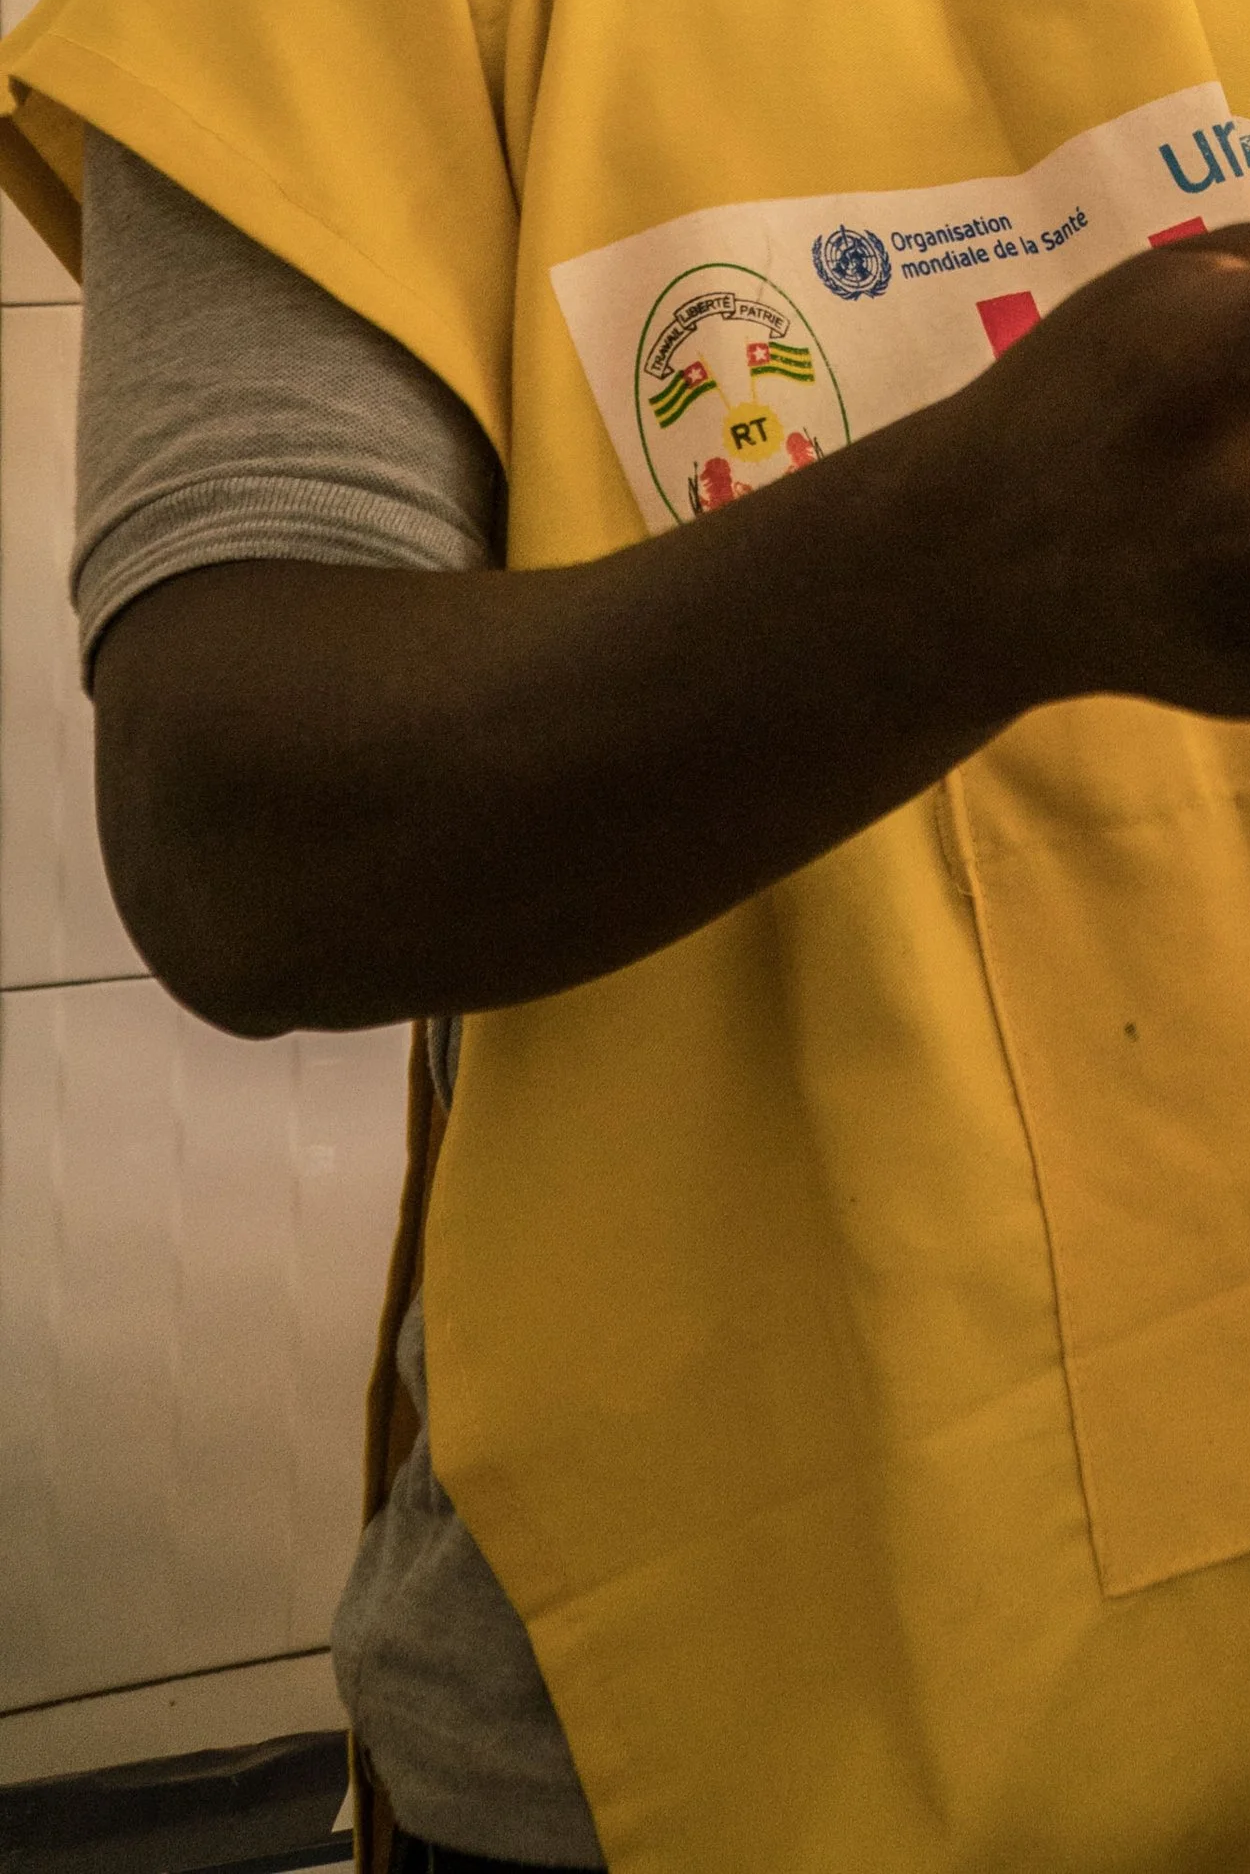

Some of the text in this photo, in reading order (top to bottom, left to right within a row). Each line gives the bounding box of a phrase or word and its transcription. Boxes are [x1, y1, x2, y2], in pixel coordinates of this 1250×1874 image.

[890, 214, 1013, 254] Organisation
[900, 206, 1089, 280] mondiale de la Santé
[650, 295, 785, 373] TRAVAIL LIBERTÉ PATRIE
[730, 417, 768, 451] RT
